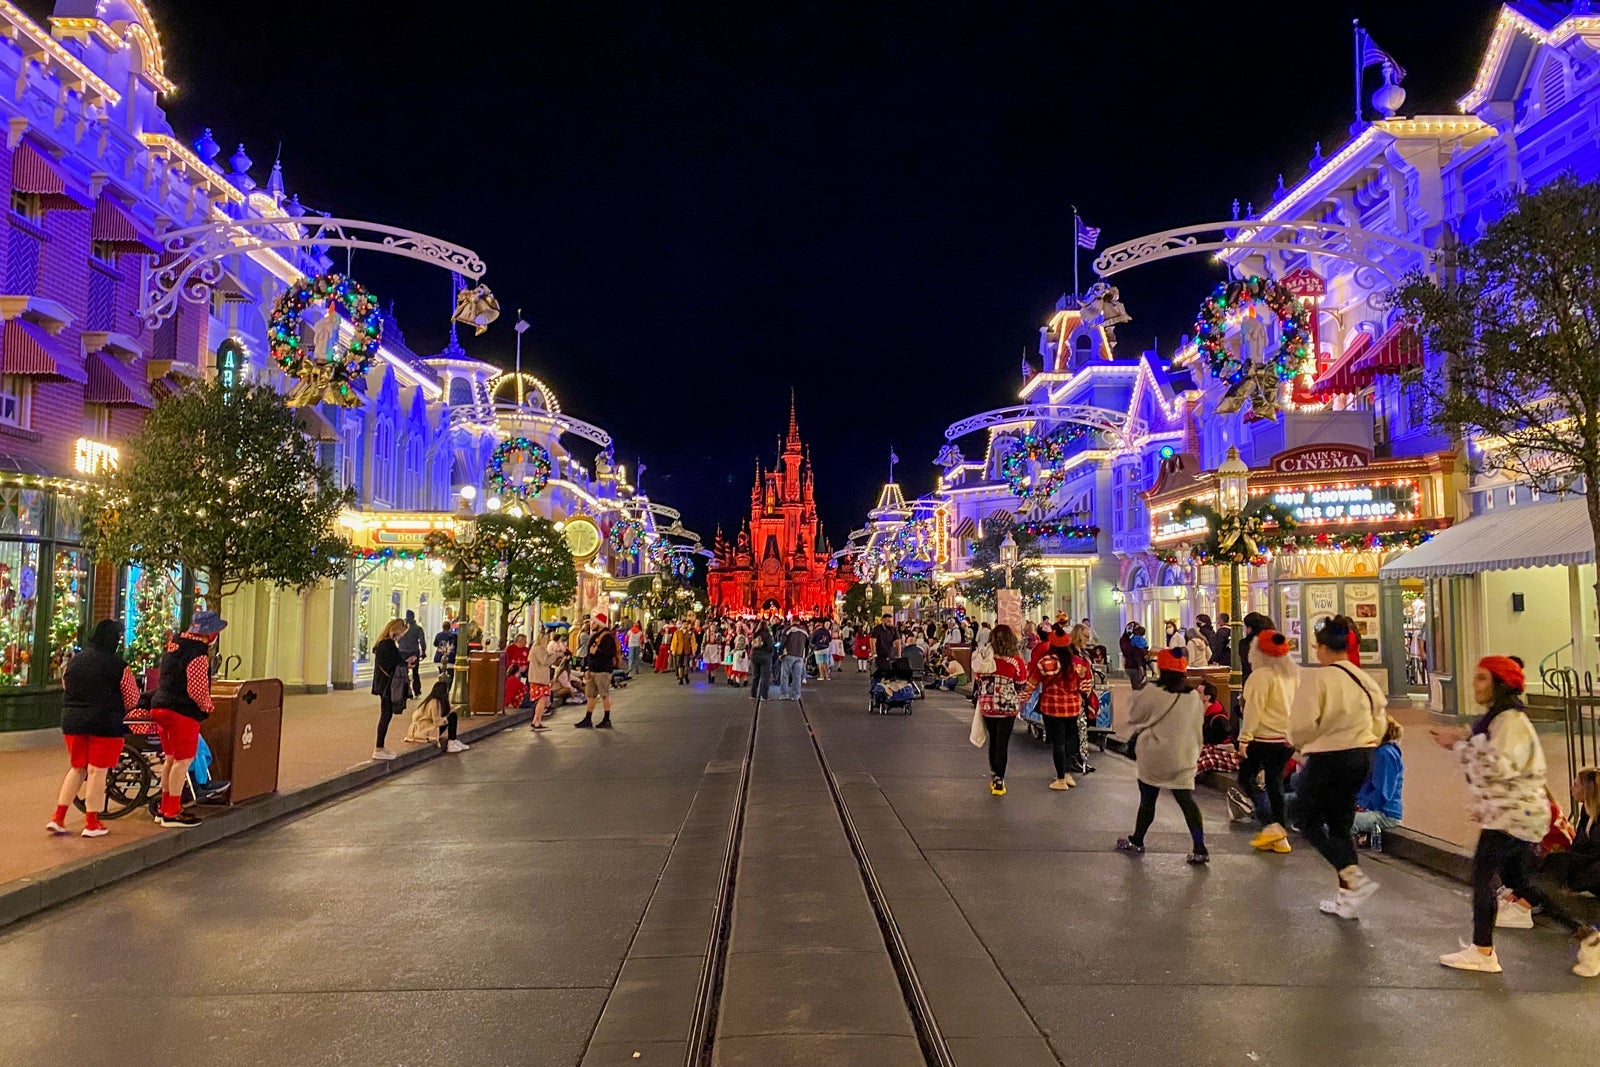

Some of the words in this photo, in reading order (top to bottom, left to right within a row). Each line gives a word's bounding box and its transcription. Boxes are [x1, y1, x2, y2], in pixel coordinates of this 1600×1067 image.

[1286, 278, 1319, 290] MAIN
[1280, 454, 1365, 472] CINEMA
[1301, 451, 1329, 460] MAIN
[1275, 493, 1305, 505] NOW
[1312, 489, 1372, 503] SHOWING
[1325, 505, 1345, 518] OF
[1349, 502, 1397, 516] MAGIC
